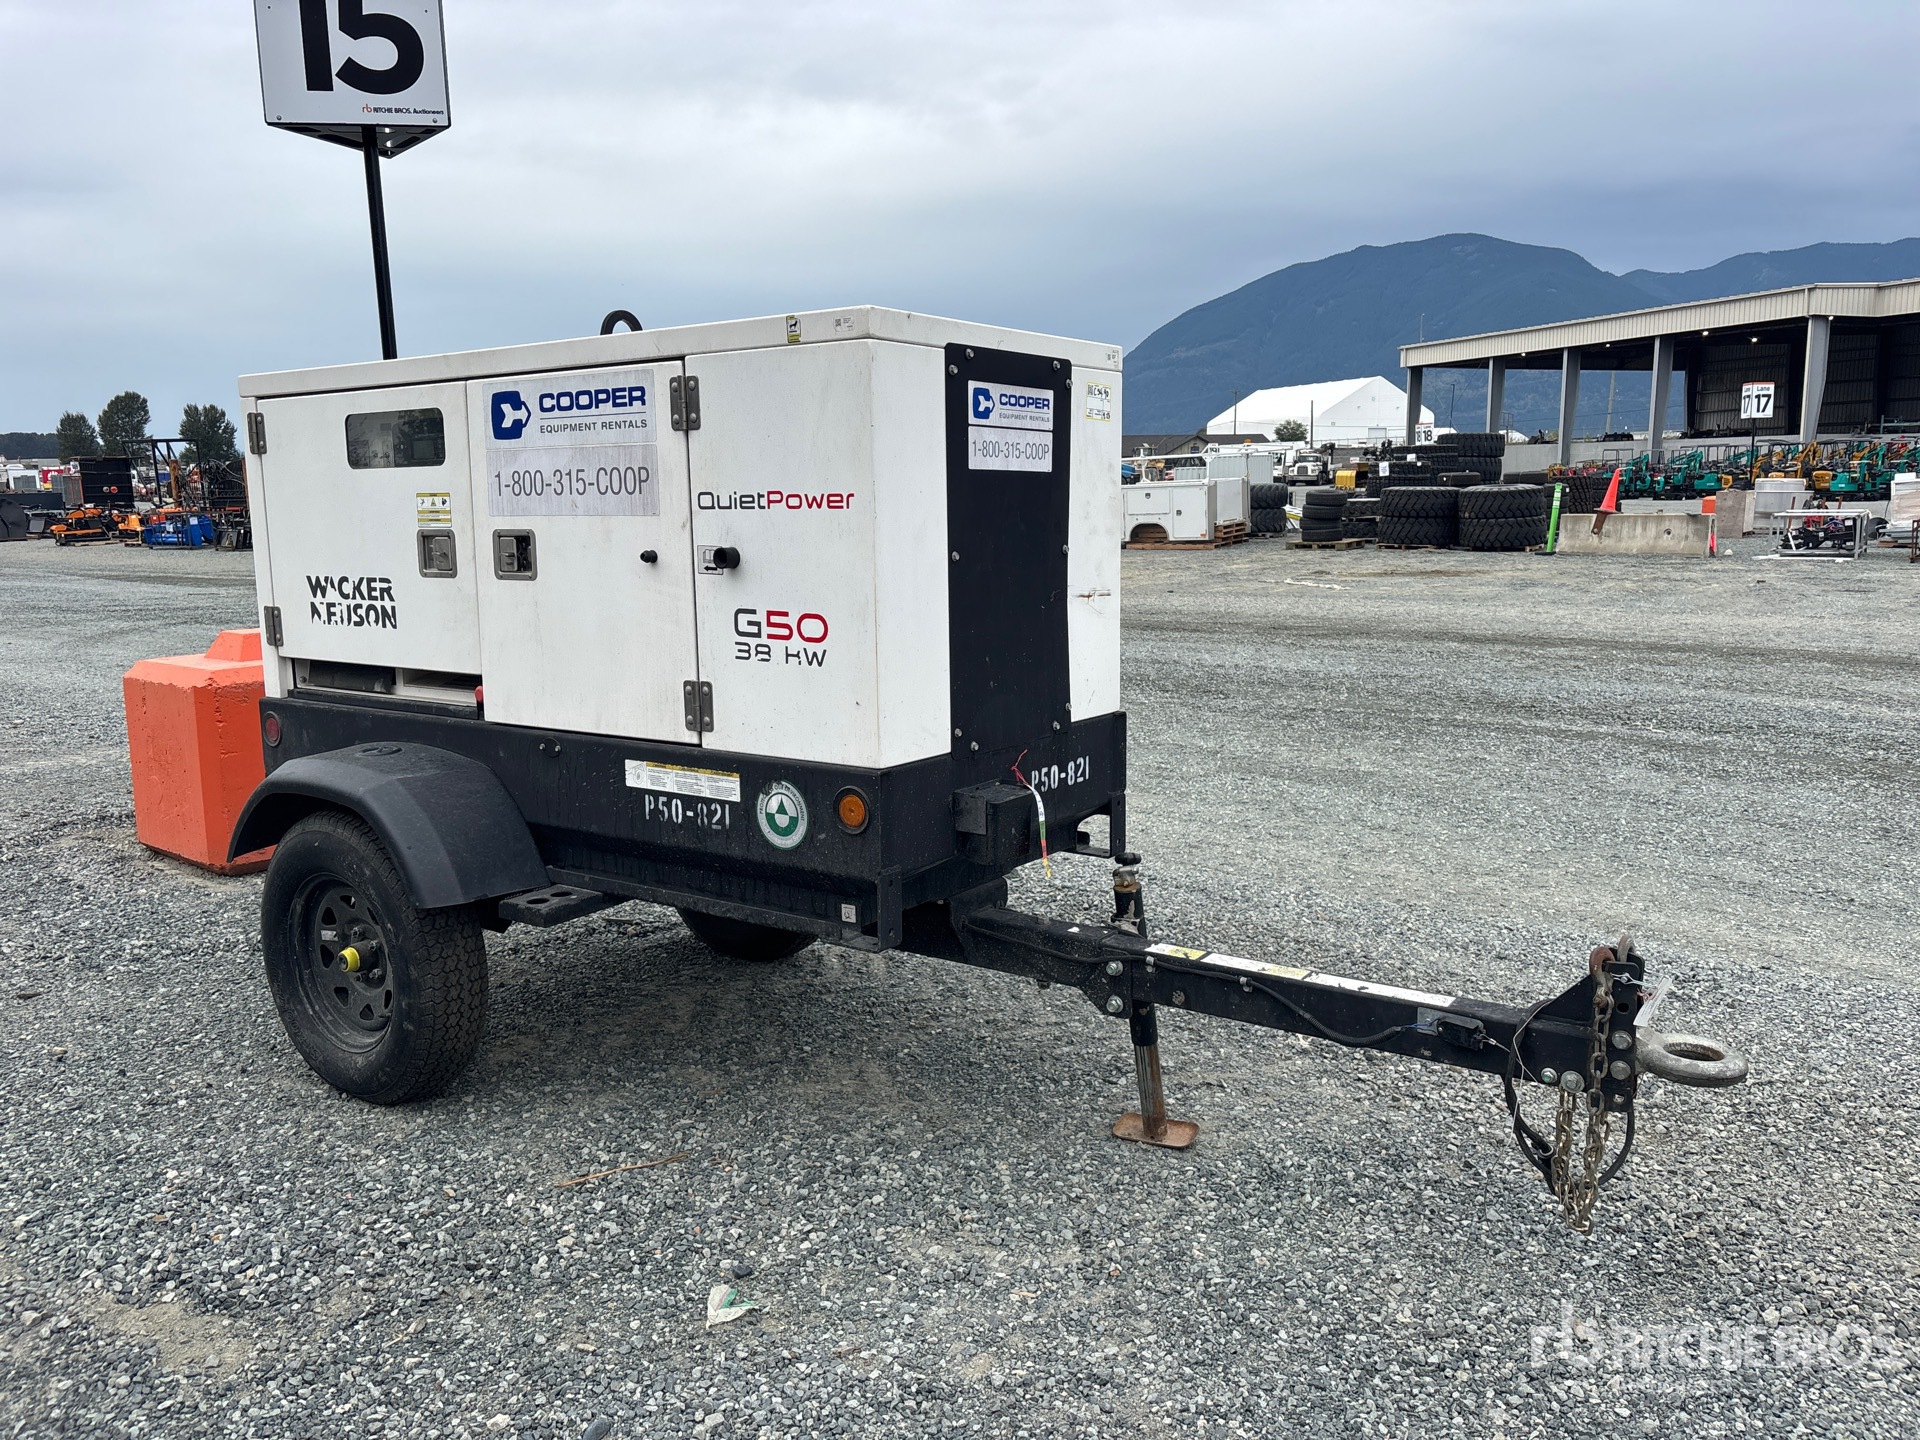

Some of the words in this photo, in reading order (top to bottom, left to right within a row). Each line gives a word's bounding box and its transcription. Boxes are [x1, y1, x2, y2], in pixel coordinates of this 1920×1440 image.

[299, 0, 424, 95] 15
[373, 106, 394, 114] RITCHIE
[539, 386, 647, 413] COOPER
[999, 393, 1050, 411] COOPER
[1755, 394, 1772, 413] 17
[540, 422, 598, 434] EQUIPMENT
[601, 419, 648, 431] RENTALS
[999, 412, 1028, 421] EQUIPMENT
[1029, 415, 1050, 423] RENTALS
[1423, 430, 1432, 442] 18
[972, 439, 1050, 461] 1-800-315-COOP
[494, 466, 650, 497] 1-800-315-COOP
[698, 490, 855, 510] QuietPower
[734, 607, 829, 644] G50
[734, 641, 772, 663] 38
[1032, 755, 1090, 793] P50-821
[645, 793, 730, 831] P50-821
